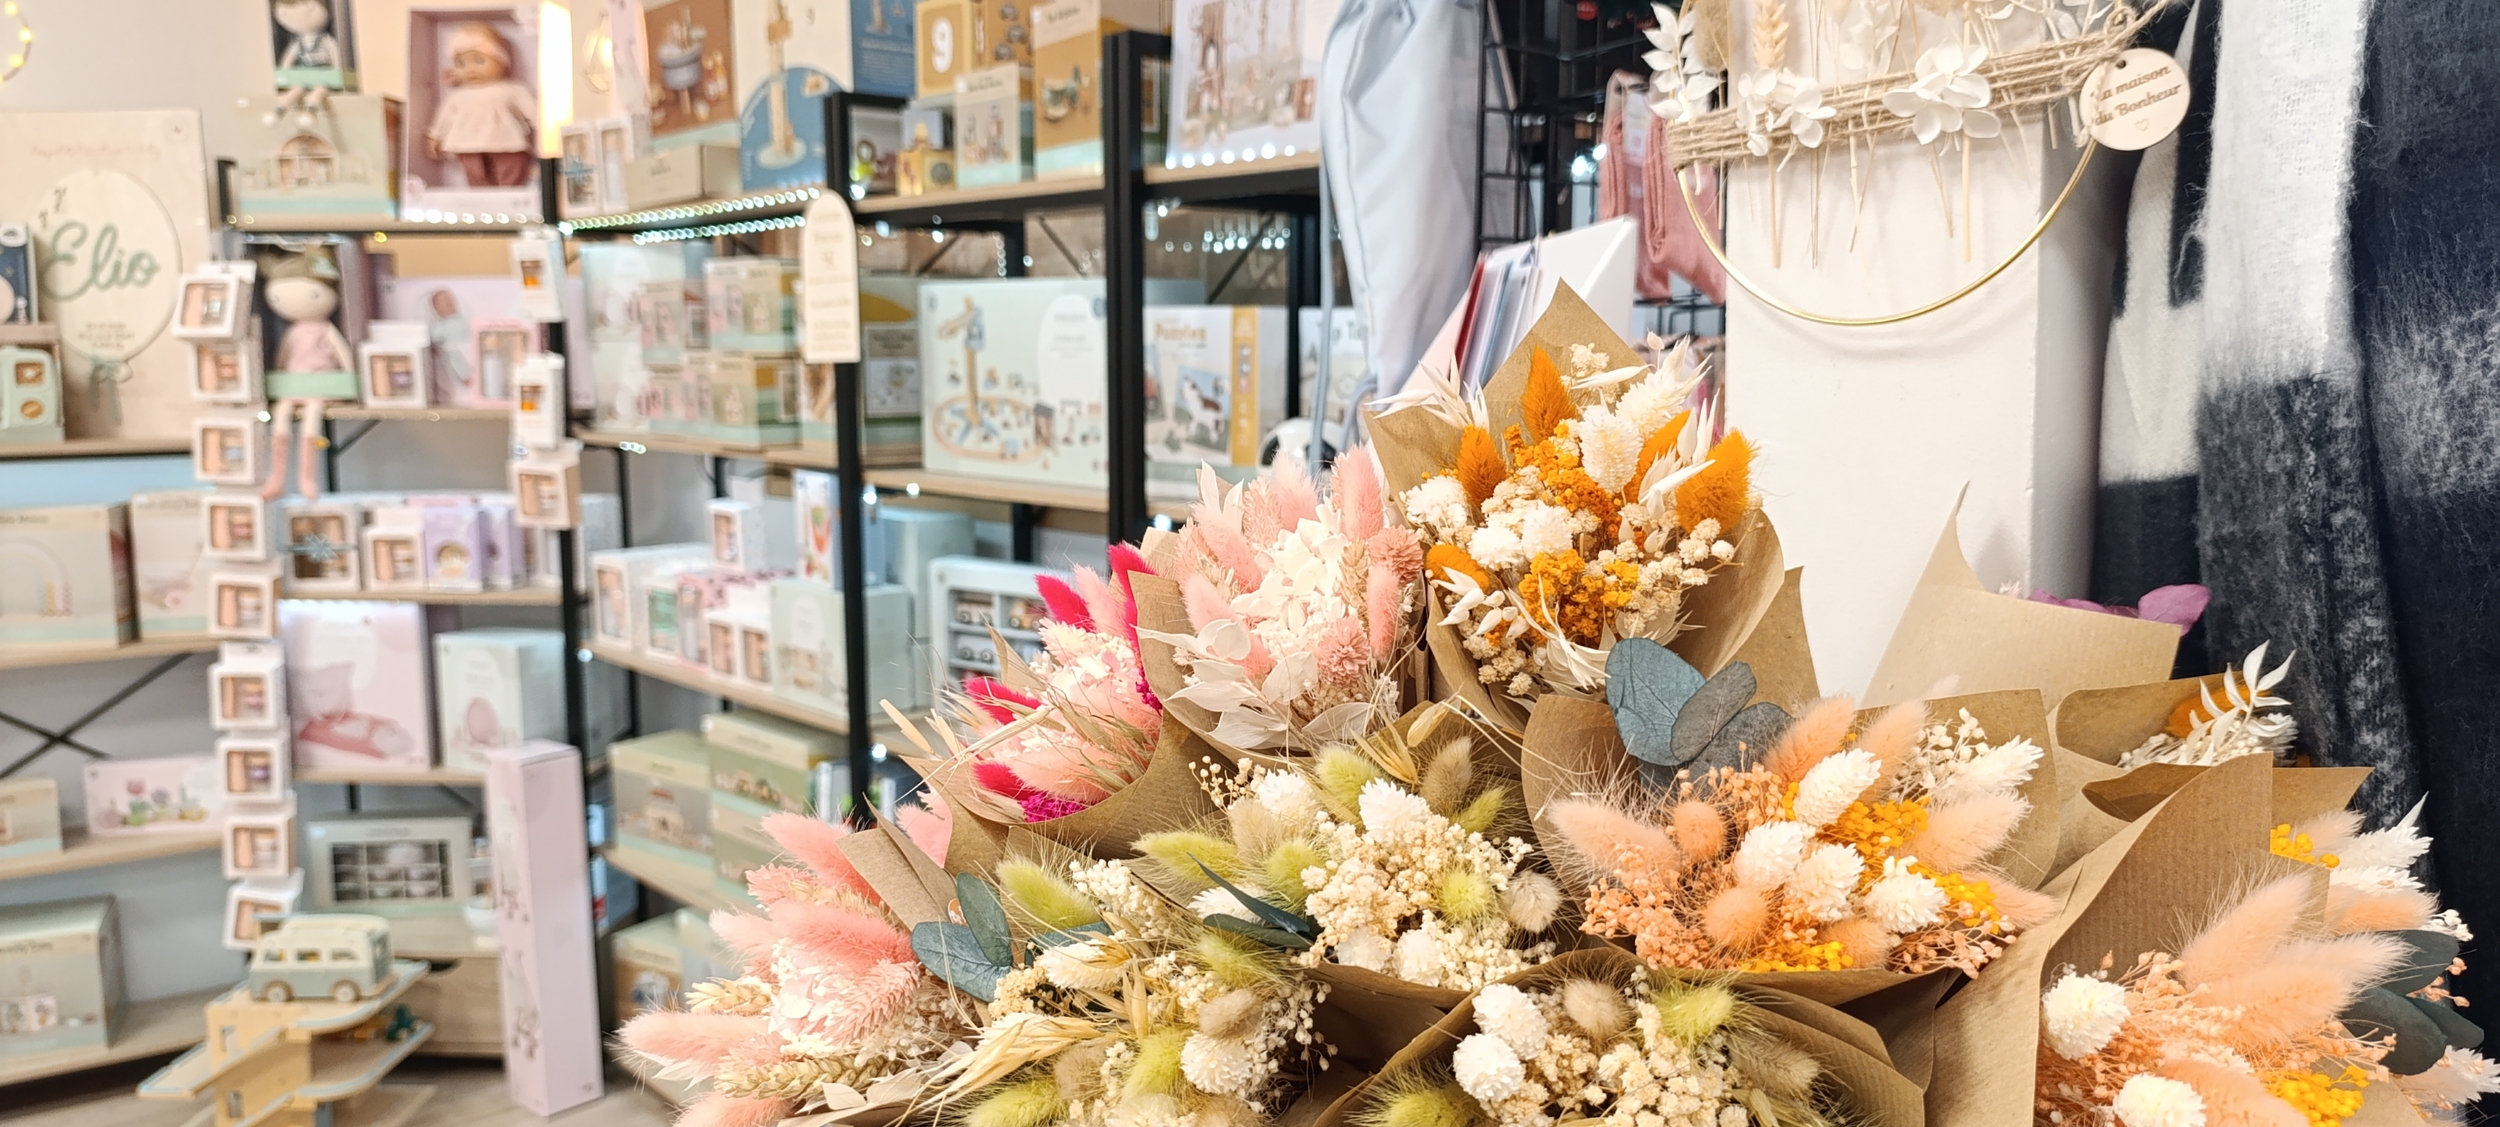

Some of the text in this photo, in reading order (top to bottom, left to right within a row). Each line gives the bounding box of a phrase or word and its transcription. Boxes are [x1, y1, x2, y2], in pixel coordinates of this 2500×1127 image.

[931, 17, 954, 74] 9
[2090, 66, 2172, 102] a maison
[2094, 84, 2182, 126] du Bonheur
[44, 220, 159, 302] Elio
